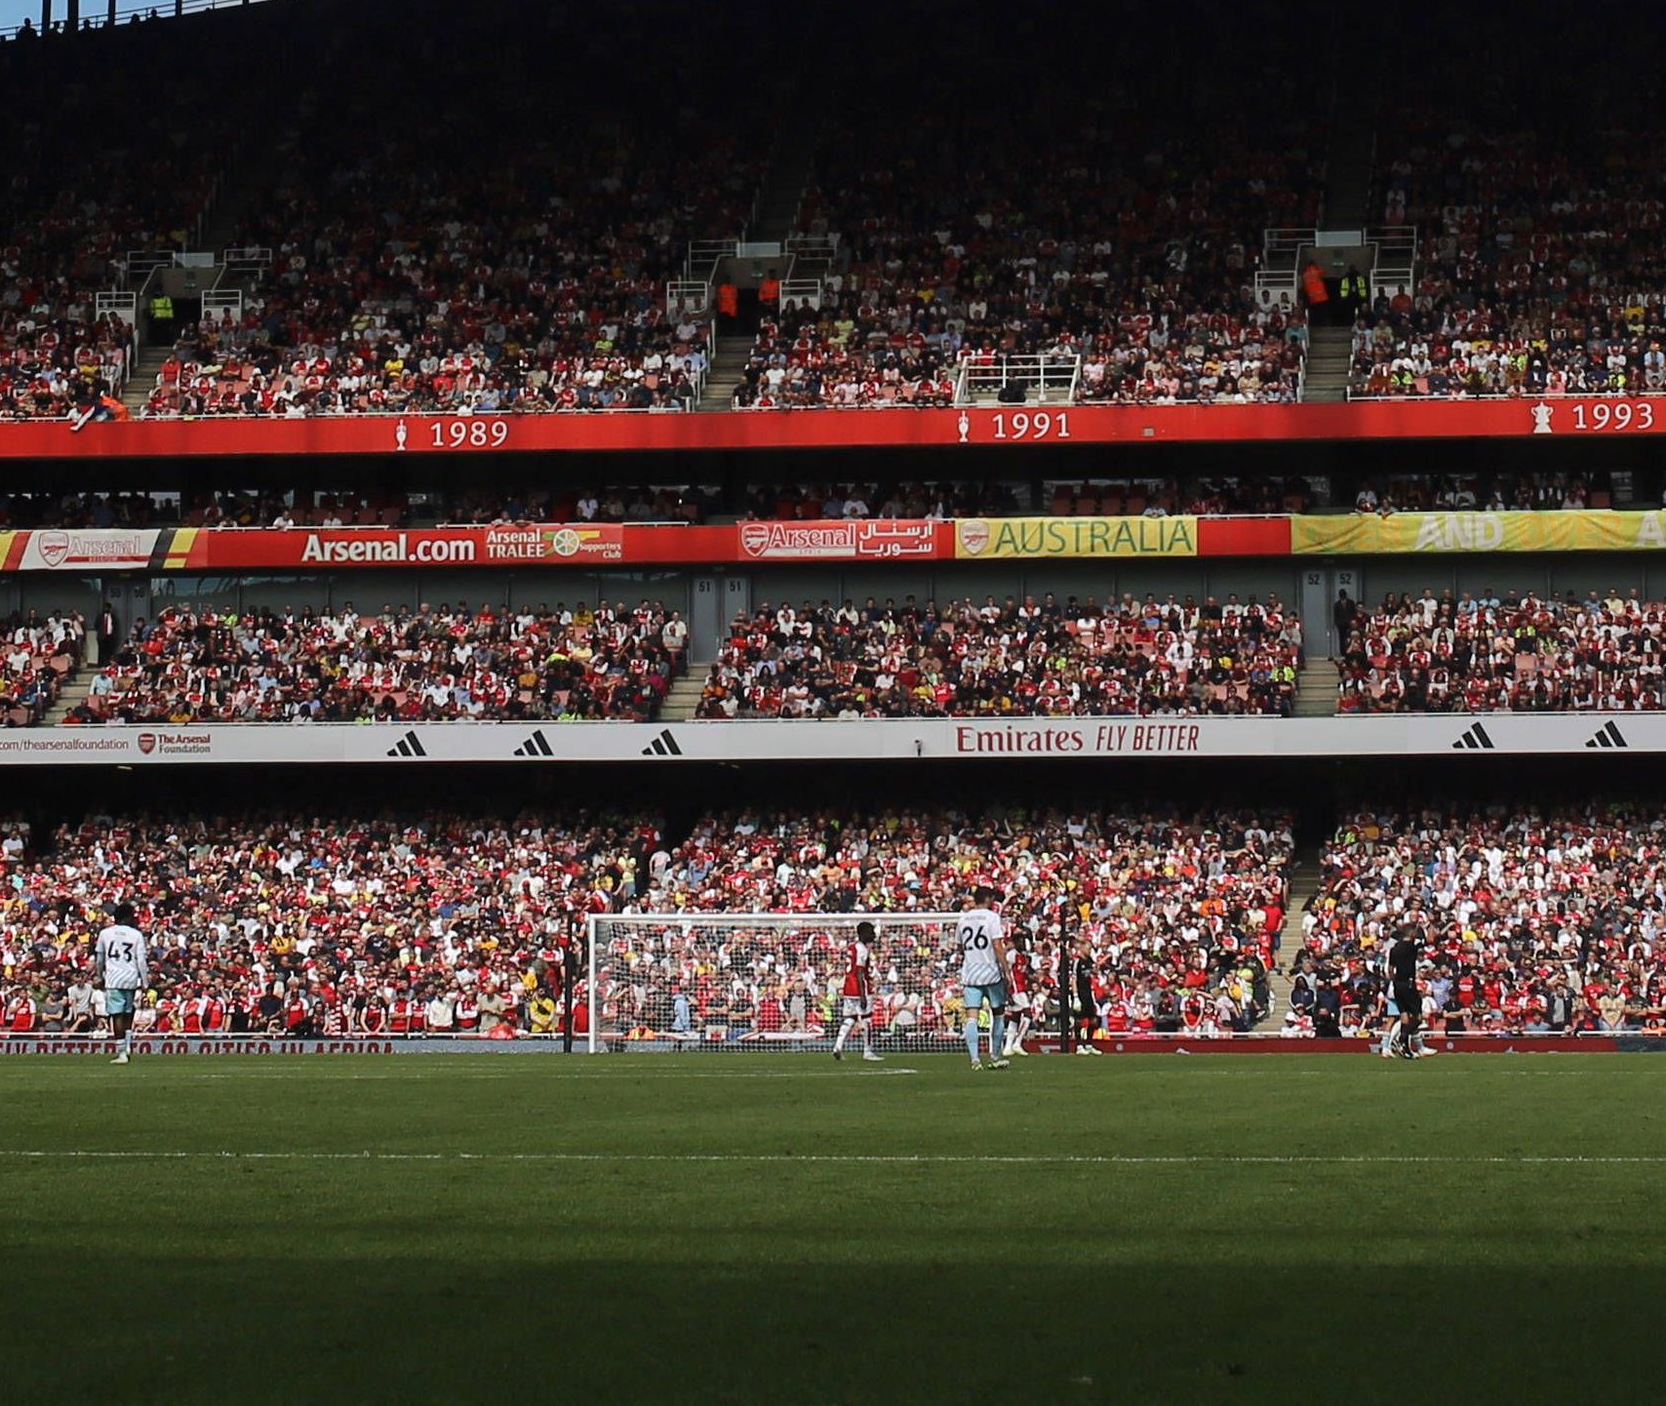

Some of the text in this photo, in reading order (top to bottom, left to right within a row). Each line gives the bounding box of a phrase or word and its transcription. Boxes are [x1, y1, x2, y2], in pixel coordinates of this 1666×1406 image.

[992, 412, 1070, 439] 1991
[1572, 402, 1655, 430] 1993
[430, 420, 508, 447] 1989
[486, 527, 541, 544] Arsenal
[769, 523, 856, 548] Arsenal
[995, 520, 1193, 555] AUSTRALIA
[1415, 513, 1504, 550] AND
[70, 535, 142, 555] Arsenal
[301, 533, 475, 562] Arsenal.com
[487, 544, 545, 558] TRALEE
[698, 581, 712, 593] 51
[729, 581, 741, 593] 51
[1308, 573, 1321, 584] 52
[1339, 573, 1352, 584] 52
[158, 734, 211, 744] The Arsenal
[956, 724, 1201, 752] Emirates FLY BETTER
[159, 745, 211, 754] Foundation
[962, 925, 989, 951] 26
[108, 941, 133, 963] 43
